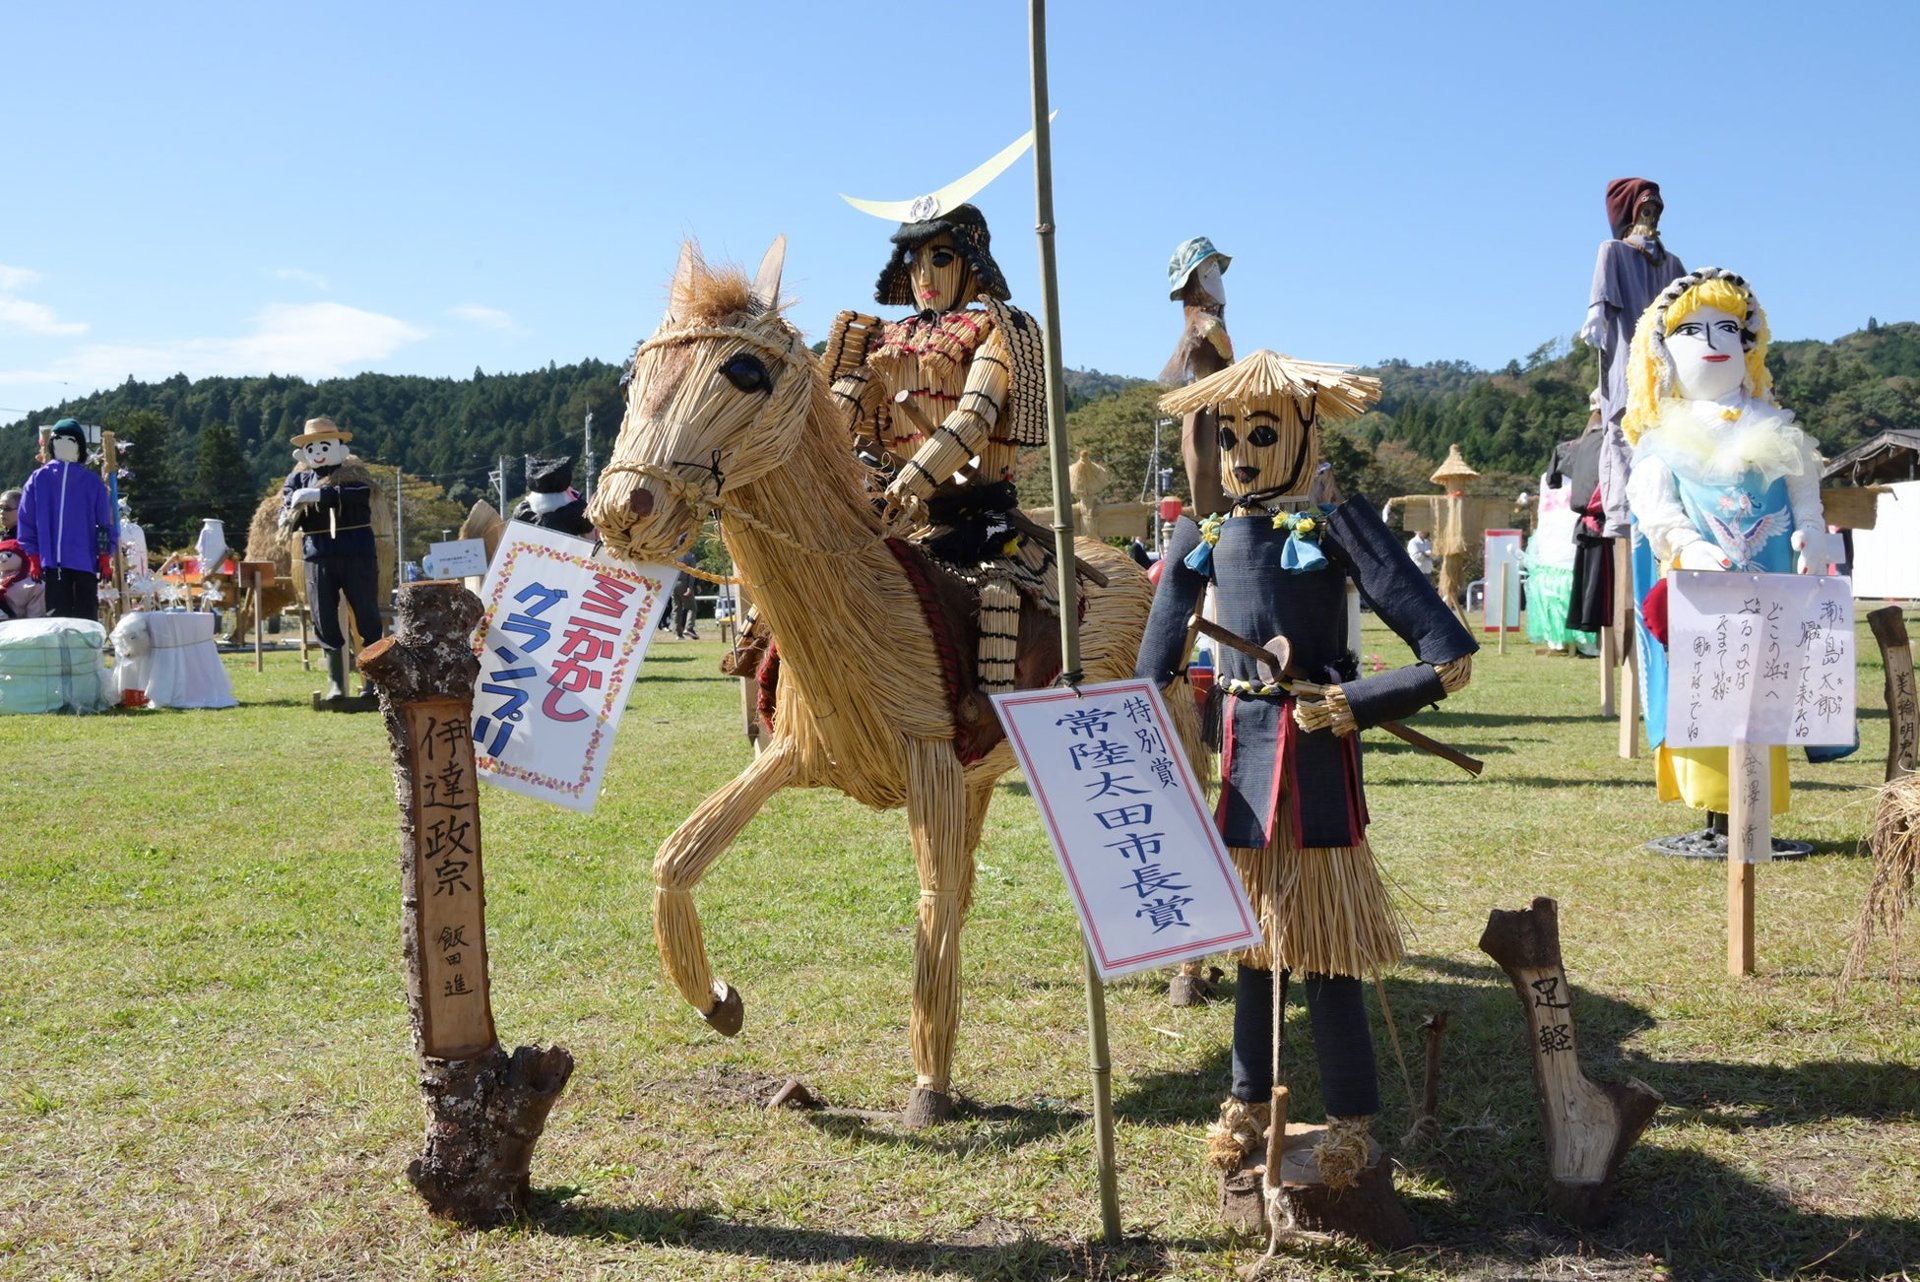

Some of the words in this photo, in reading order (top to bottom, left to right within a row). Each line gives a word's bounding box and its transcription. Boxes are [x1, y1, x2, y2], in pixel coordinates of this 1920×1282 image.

[473, 582, 568, 758] グランプリ
[542, 573, 636, 722] ミニかかし
[1764, 601, 1784, 700] どこの浜へ
[1813, 600, 1840, 724] 浦島太郎
[1123, 696, 1178, 789] 特別賞
[420, 716, 475, 897] 伊達政宗
[1055, 708, 1195, 935] 常陸太田市長賞
[437, 924, 474, 998] 飯田進
[1531, 977, 1573, 1056] 足軽
